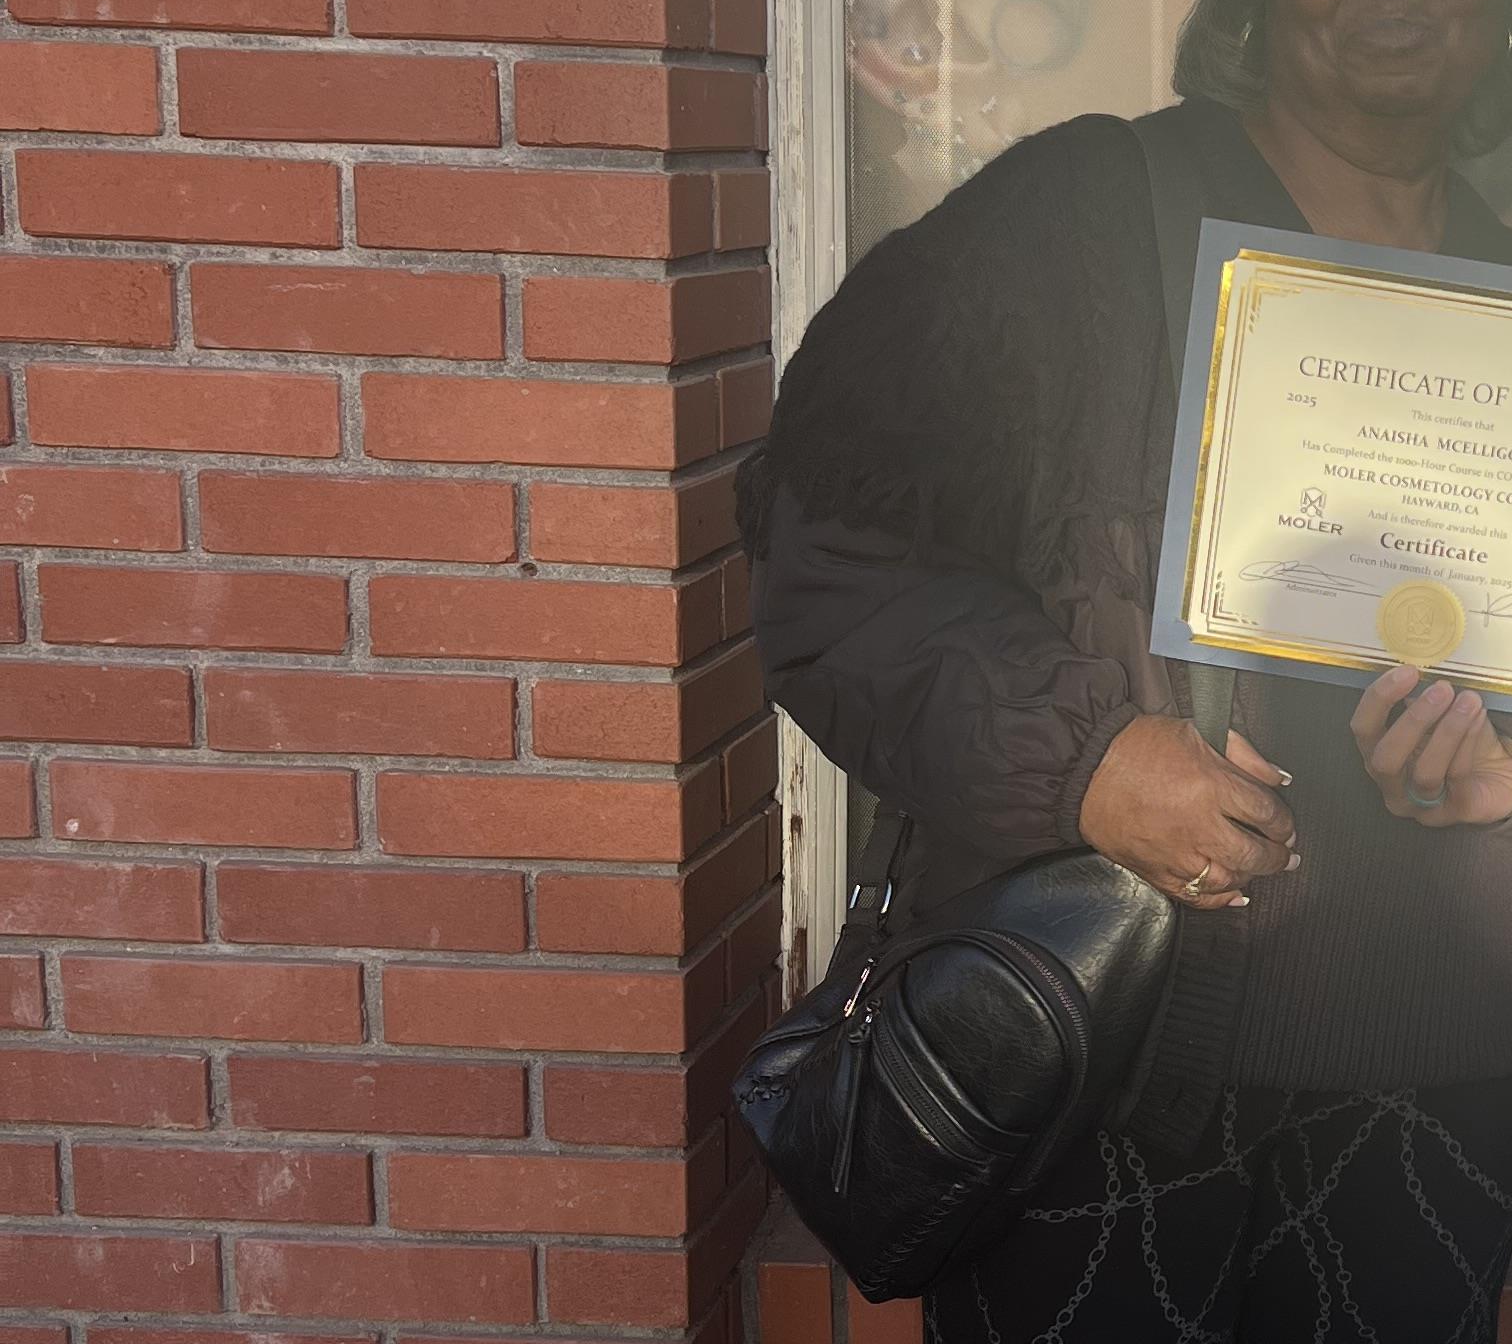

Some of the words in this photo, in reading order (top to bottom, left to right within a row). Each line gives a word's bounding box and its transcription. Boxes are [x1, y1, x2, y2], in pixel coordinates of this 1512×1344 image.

[1299, 356, 1465, 401] CERTIFICATE
[1472, 383, 1510, 406] OF
[1286, 392, 1318, 408] 2025
[1411, 409, 1433, 422] This
[1434, 416, 1473, 428] certifies
[1474, 420, 1495, 432] that
[1357, 425, 1429, 448] ANAISHA
[1302, 439, 1321, 451] Has
[1322, 442, 1376, 460] Completed
[1377, 452, 1394, 464] the
[1395, 457, 1447, 472] 1000-Hour
[1448, 463, 1483, 478] Course
[1483, 469, 1494, 479] in
[1324, 463, 1376, 484] MOLER
[1379, 473, 1493, 501] COSMETOLOGY
[1401, 494, 1462, 514] HAYWARD,
[1464, 504, 1479, 516] CA
[1278, 514, 1343, 536] MOLER
[1368, 509, 1389, 521] And
[1390, 512, 1398, 523] is
[1400, 514, 1445, 530] therefore
[1445, 524, 1488, 537] awarded
[1489, 527, 1508, 540] this
[1380, 532, 1488, 564] Certificate
